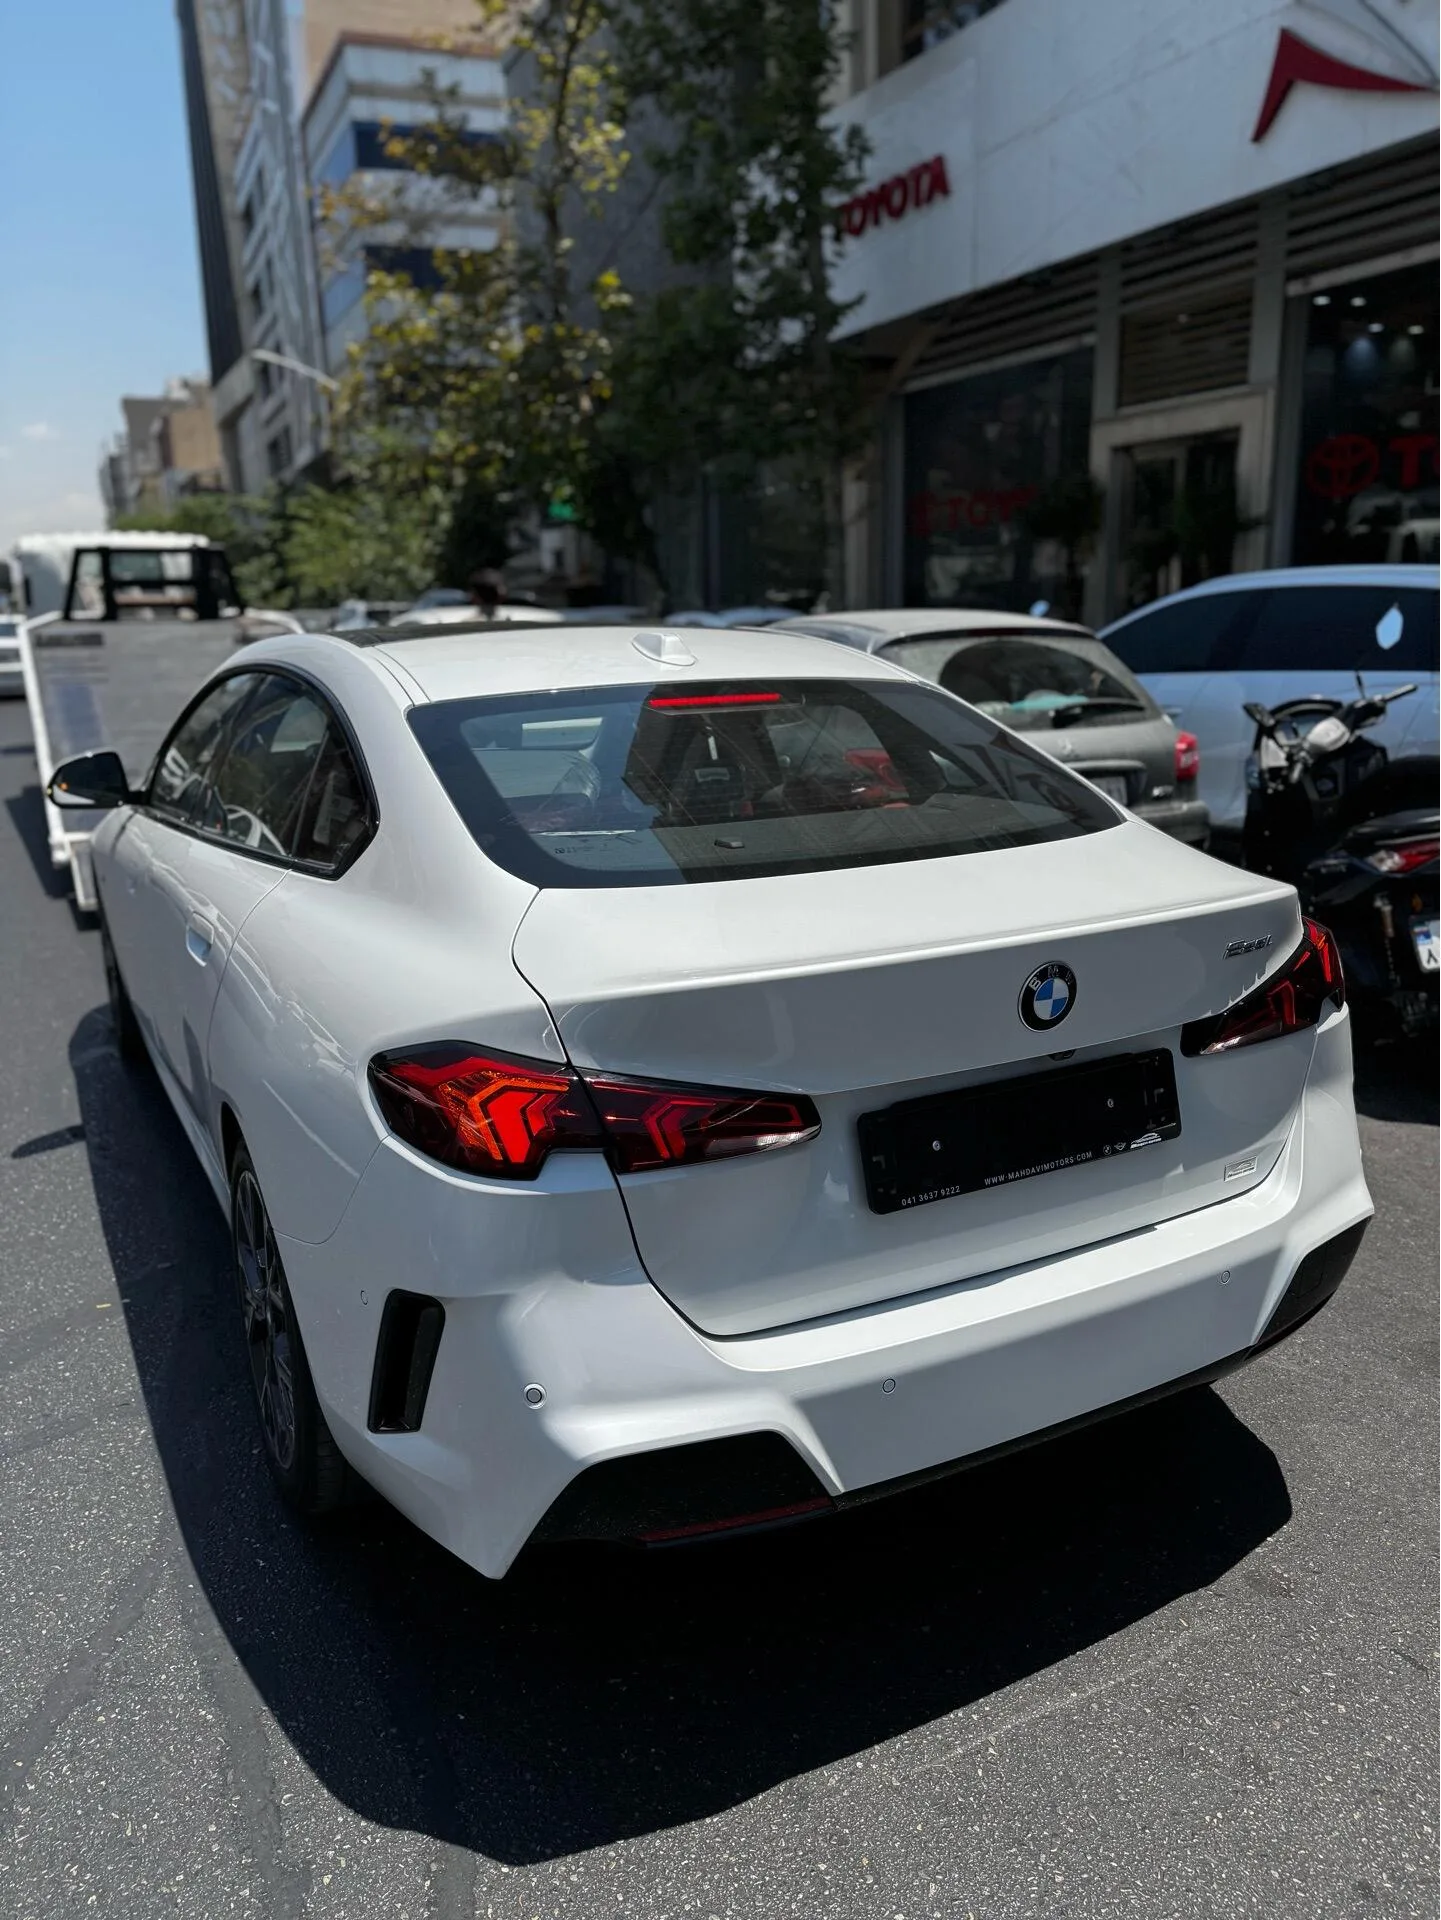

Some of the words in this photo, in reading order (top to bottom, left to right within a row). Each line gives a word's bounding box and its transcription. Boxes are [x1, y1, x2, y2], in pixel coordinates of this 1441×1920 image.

[1388, 433, 1440, 490] T
[901, 1195, 917, 1206] 041
[918, 1191, 939, 1202] 3637
[940, 1185, 961, 1197] 9222
